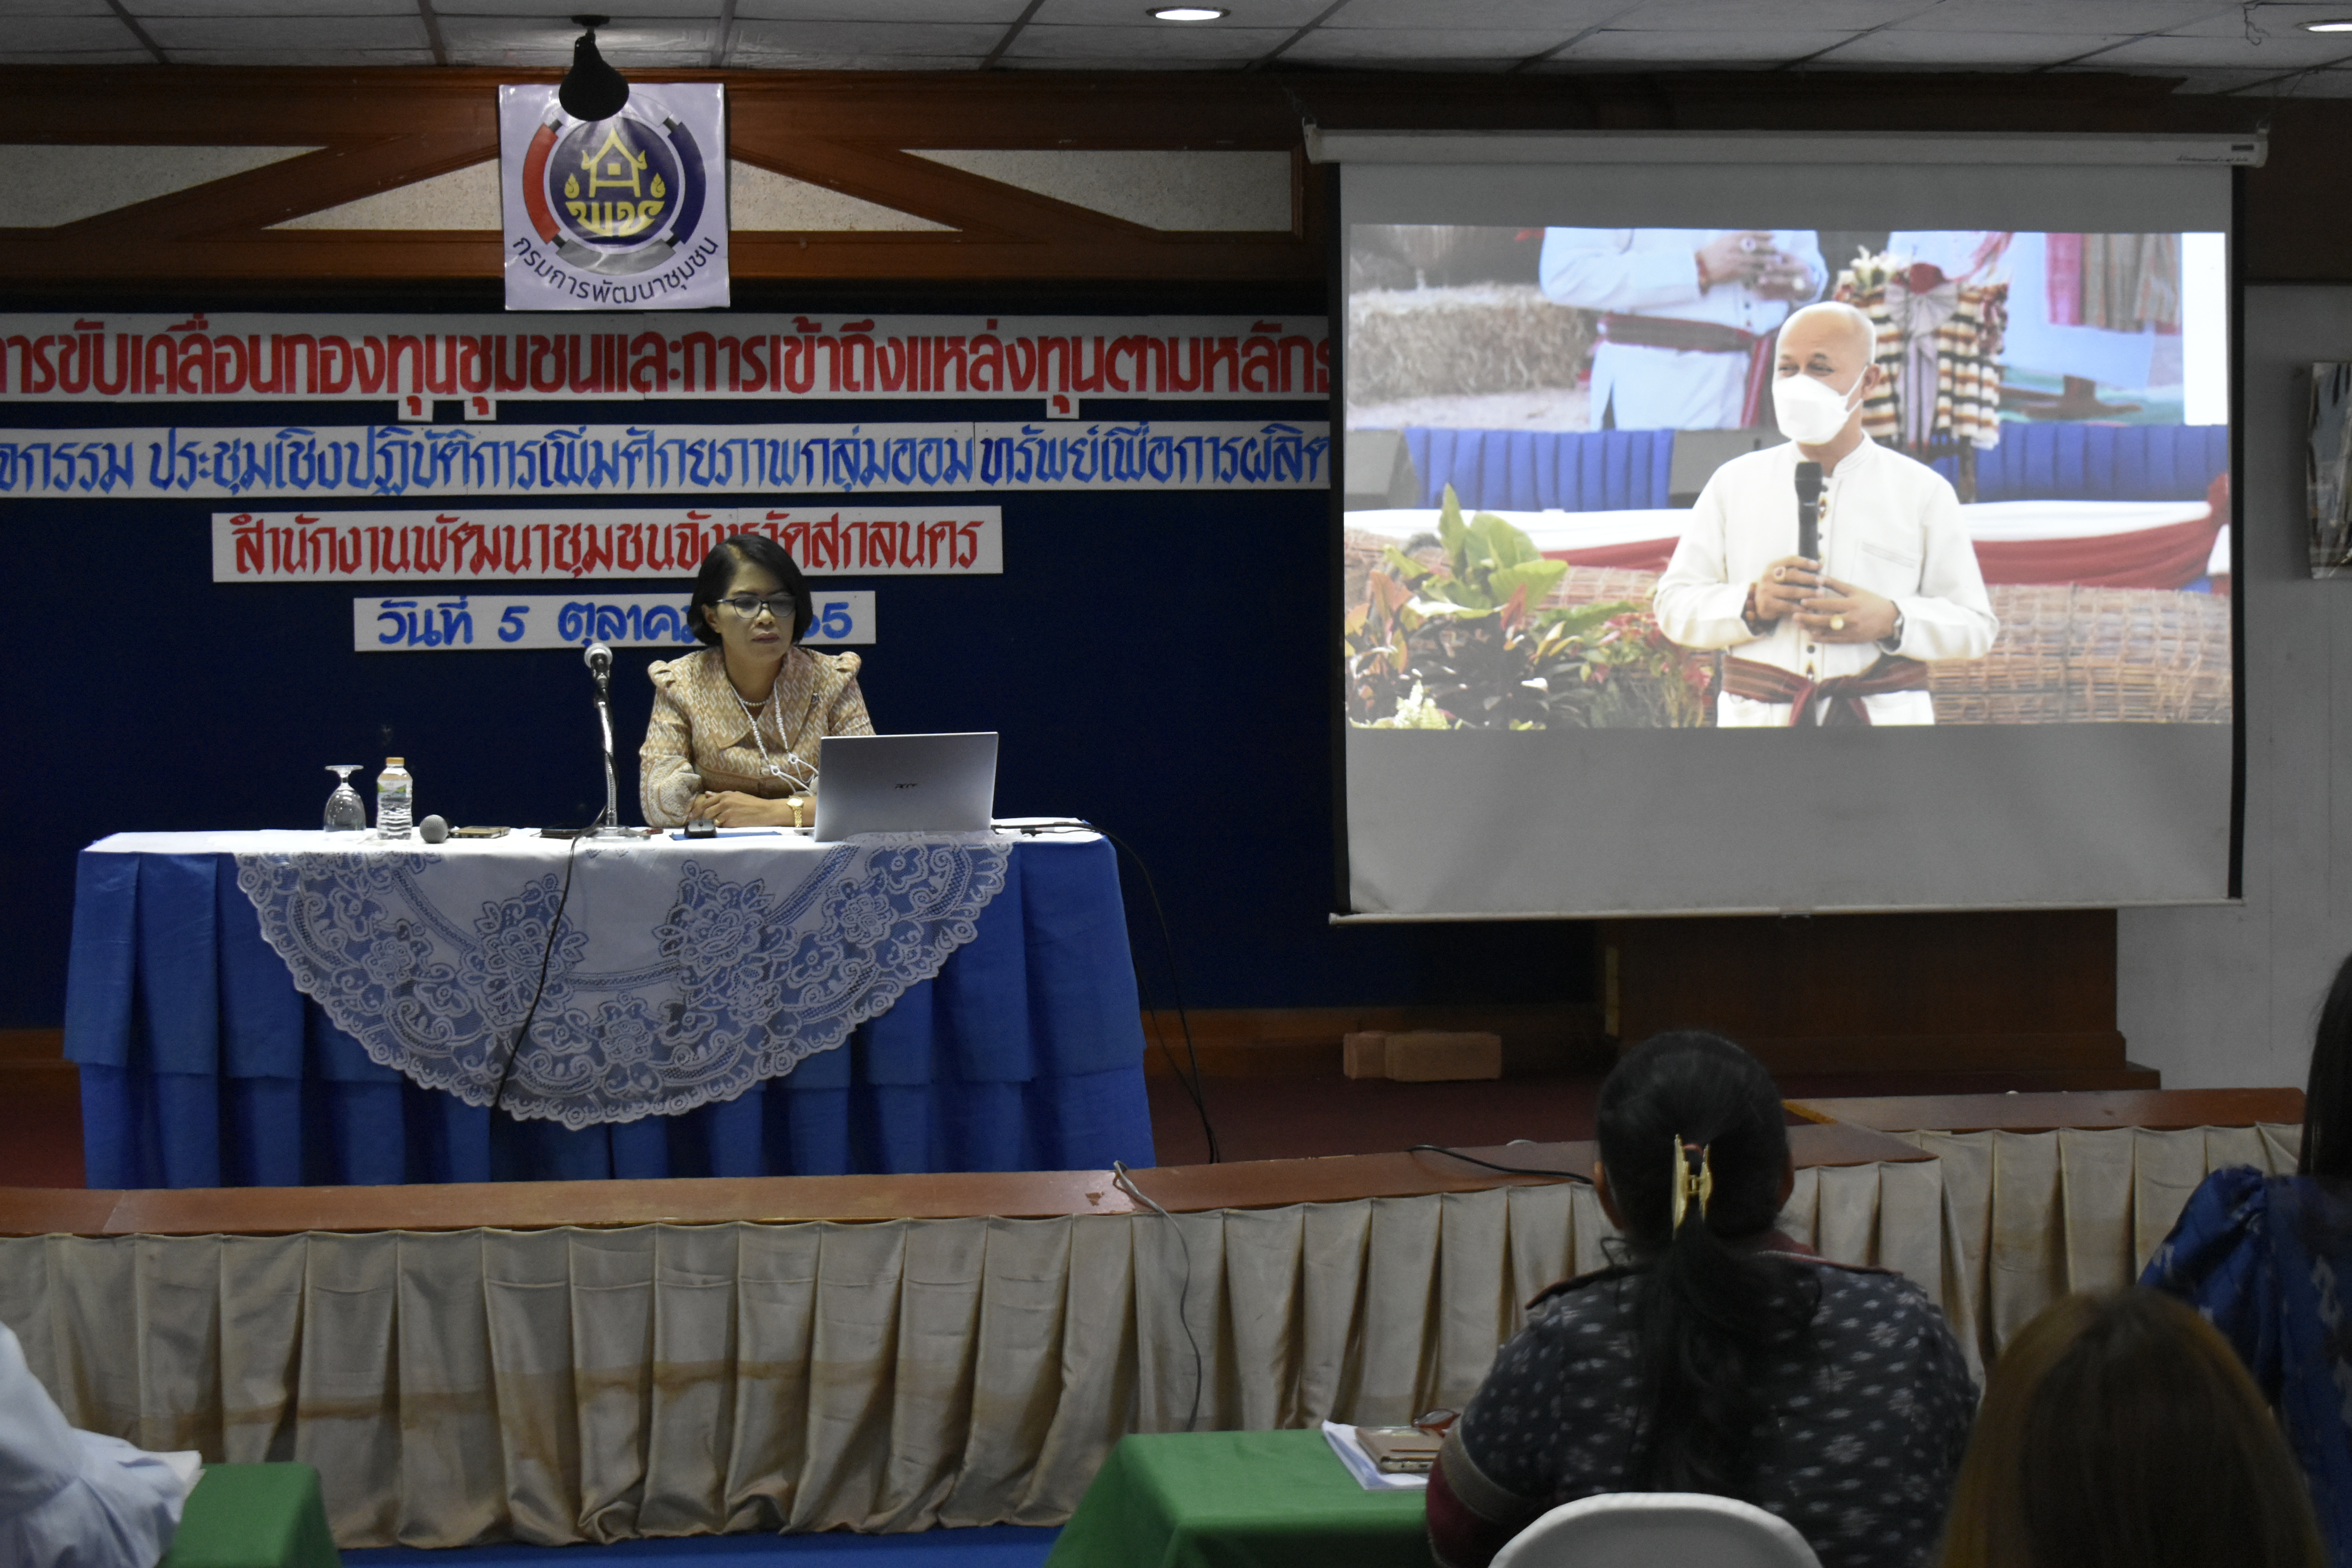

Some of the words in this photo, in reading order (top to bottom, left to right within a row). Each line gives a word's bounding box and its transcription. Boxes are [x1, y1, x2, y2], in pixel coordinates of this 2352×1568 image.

[513, 237, 719, 304] กรมการพัฒนาชุมชน
[0, 313, 1330, 416] ารขับเคลื่อนกองทุนชุมชนและการเข้าถึงแหล่งทุนตามหลัก
[377, 595, 474, 647] วันที่
[497, 606, 530, 643] 5
